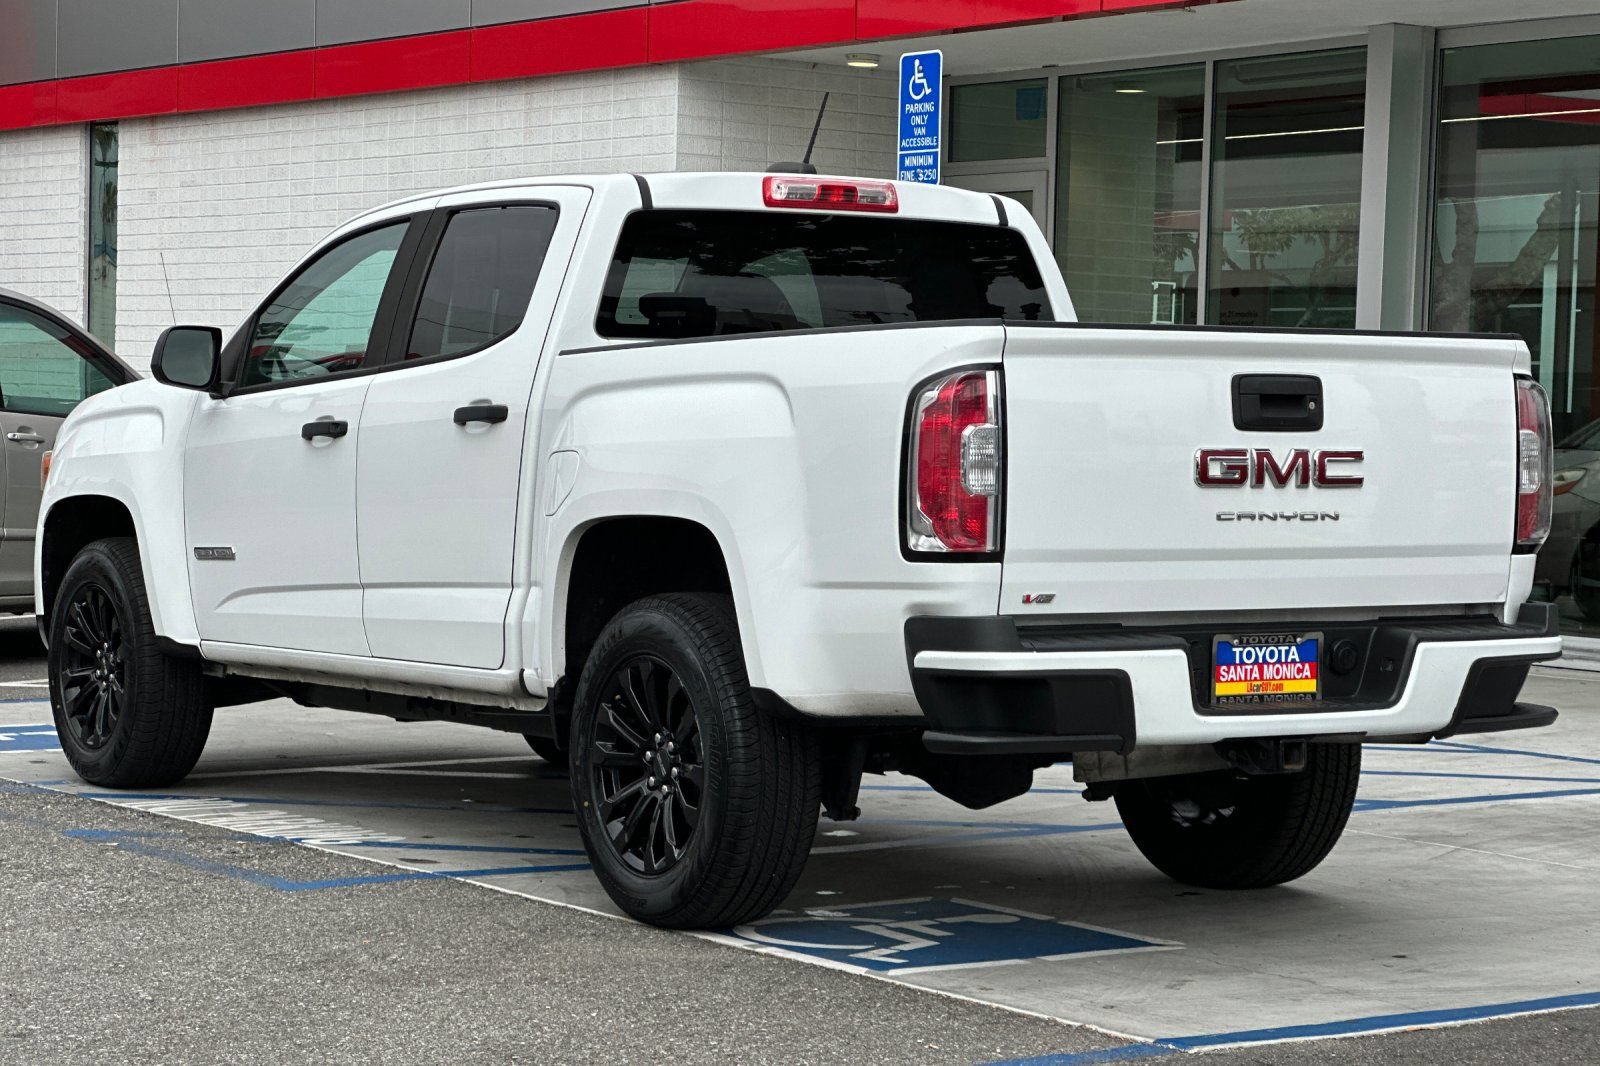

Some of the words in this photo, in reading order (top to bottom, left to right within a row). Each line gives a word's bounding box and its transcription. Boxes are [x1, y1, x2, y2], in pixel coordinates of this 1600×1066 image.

[905, 101, 935, 114] PARKING
[910, 114, 929, 126] ONLY
[913, 126, 926, 136] VAN
[901, 136, 938, 148] ACCESSIBLE
[904, 155, 934, 167] MINIMUM
[900, 170, 915, 181] FINE
[917, 168, 937, 181] $250
[1194, 448, 1364, 489] GMC
[1215, 511, 1340, 522] CANYON
[1241, 635, 1295, 644] TOYOTA
[1232, 646, 1300, 664] TOYOTA
[1219, 665, 1260, 682] SANTA
[1263, 663, 1312, 680] MONICA
[1219, 695, 1260, 704] SANTA
[1264, 693, 1313, 703] MONICA
